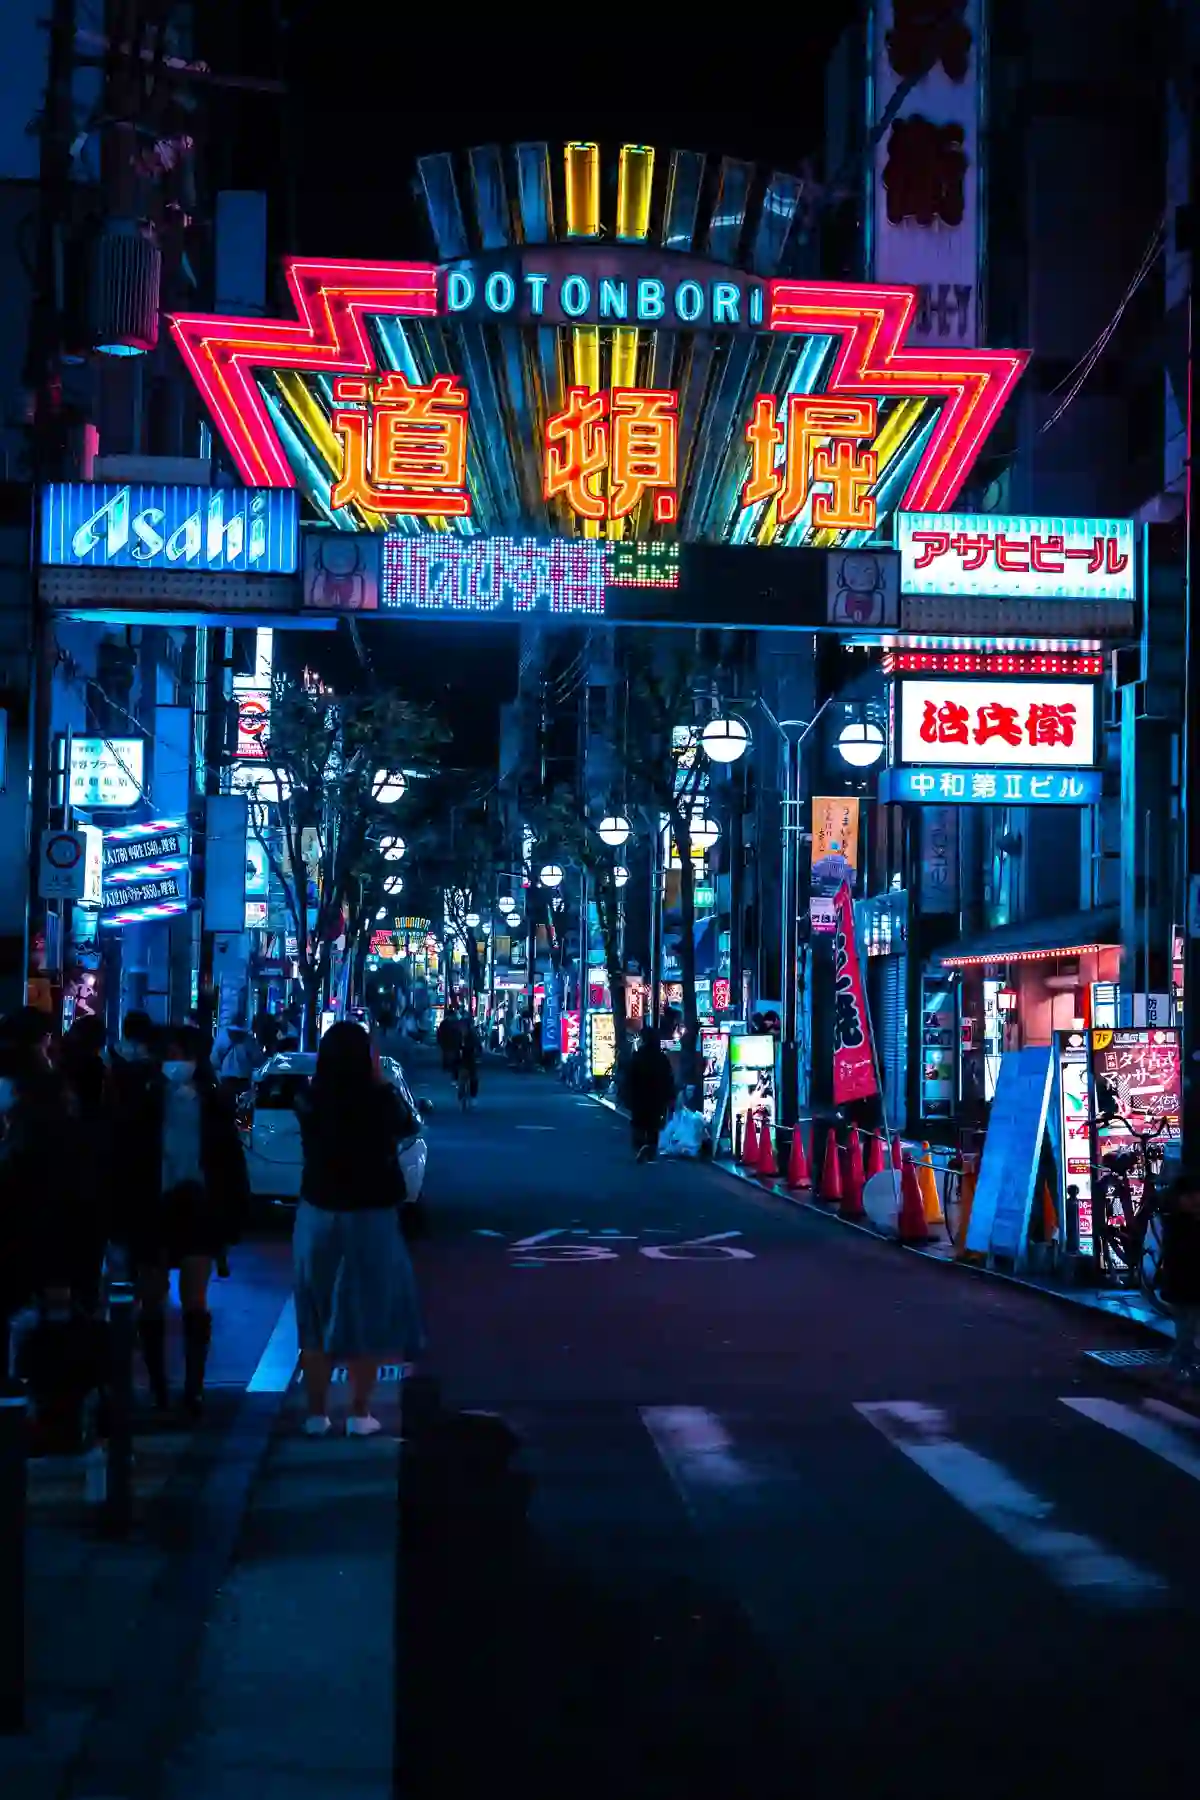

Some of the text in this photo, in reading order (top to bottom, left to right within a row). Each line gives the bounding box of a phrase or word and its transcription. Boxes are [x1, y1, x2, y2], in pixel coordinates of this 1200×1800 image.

[447, 271, 764, 324] DOTONBORI
[330, 372, 878, 531] 道頓堀
[71, 485, 268, 563] Asahi
[912, 531, 1129, 574] アサヒビール
[919, 700, 1077, 747] 治兵衛
[1095, 1033, 1109, 1043] 7F
[1119, 1051, 1175, 1069] タイ古式
[1100, 1068, 1175, 1085] マッサージ
